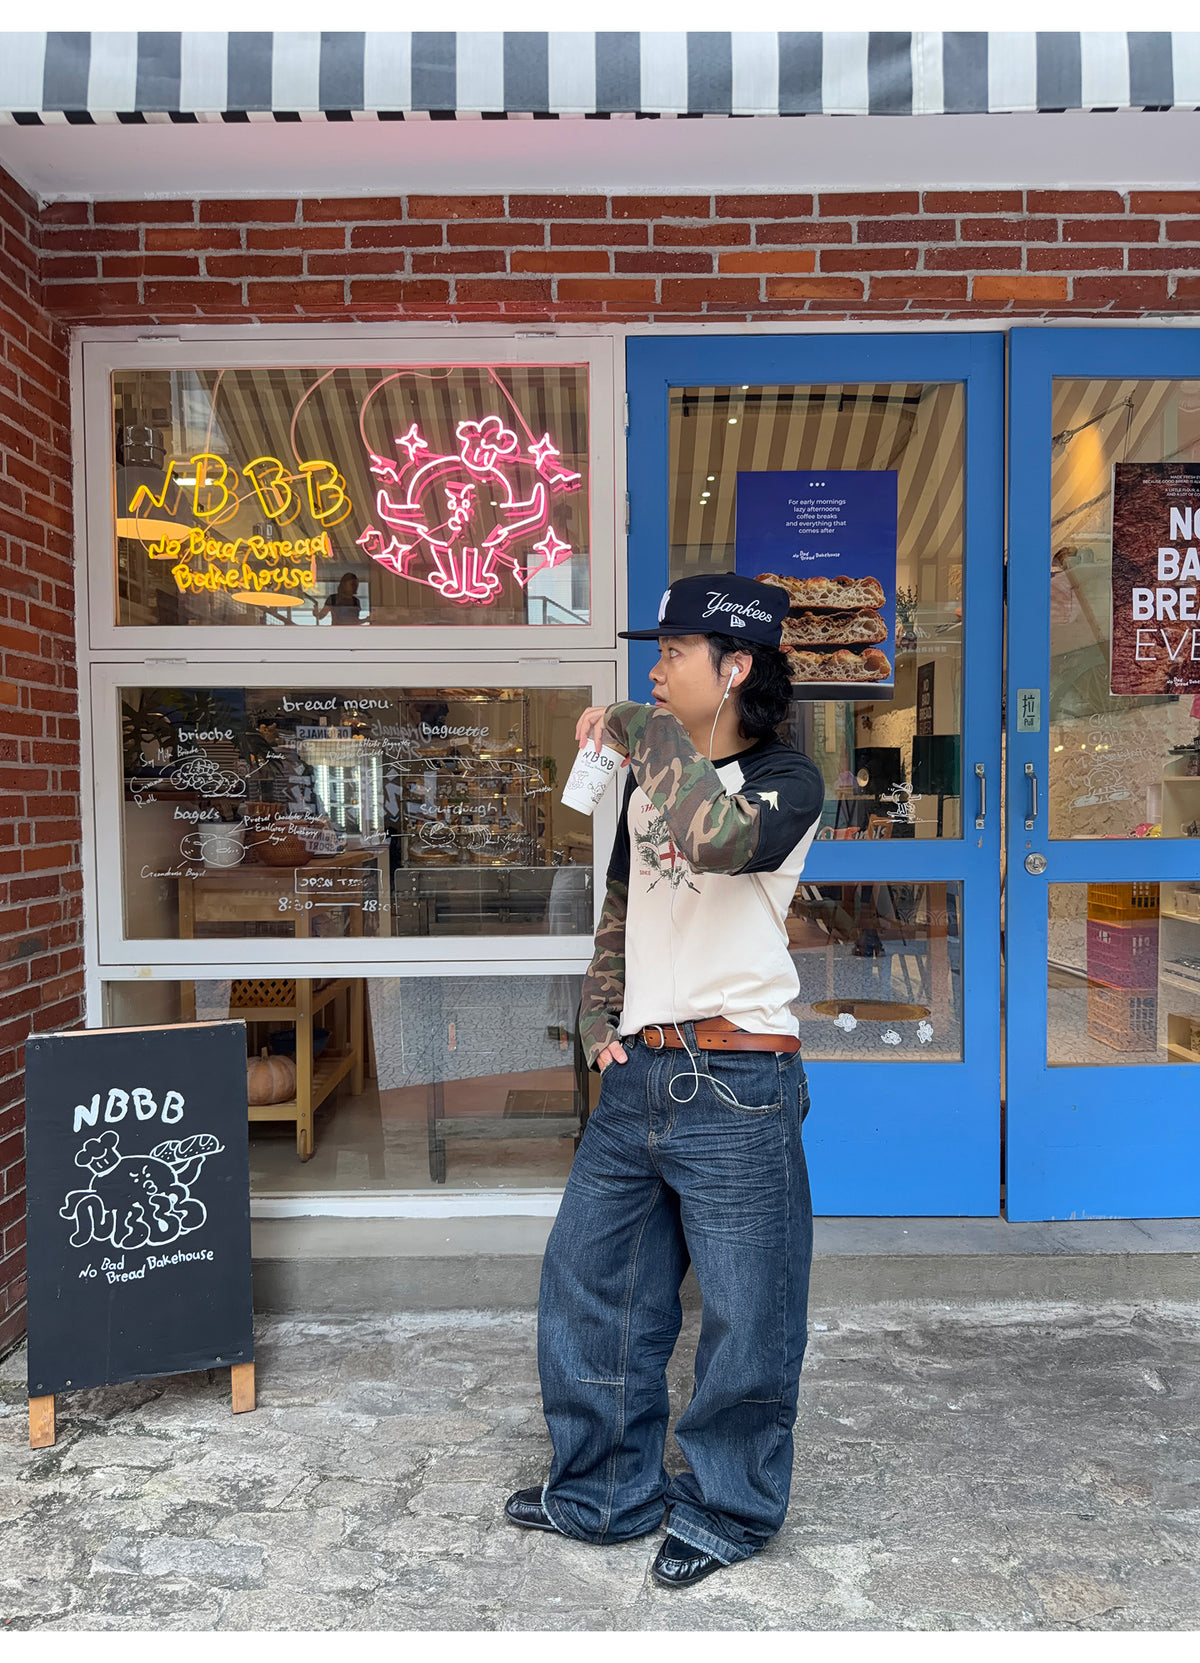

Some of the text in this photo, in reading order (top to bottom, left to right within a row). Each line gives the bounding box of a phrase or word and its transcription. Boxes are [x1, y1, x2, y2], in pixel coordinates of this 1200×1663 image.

[129, 453, 344, 519] NBBB
[798, 520, 833, 528] everything
[148, 527, 328, 562] No Bad Bread
[171, 563, 314, 592] Bakehouse
[702, 591, 773, 623] Yankees
[1132, 587, 1200, 621] BRE
[1022, 694, 1036, 718] 拉
[178, 727, 235, 743] brioche
[422, 722, 490, 739] baguette
[582, 751, 615, 770] NBBB
[134, 793, 158, 809] Roll
[420, 801, 498, 818] sourdough
[173, 807, 220, 822] bagels
[278, 896, 314, 912] 8:30
[73, 1087, 186, 1133] NBBB
[78, 1249, 214, 1285] No Bad Bread Bakehouse
